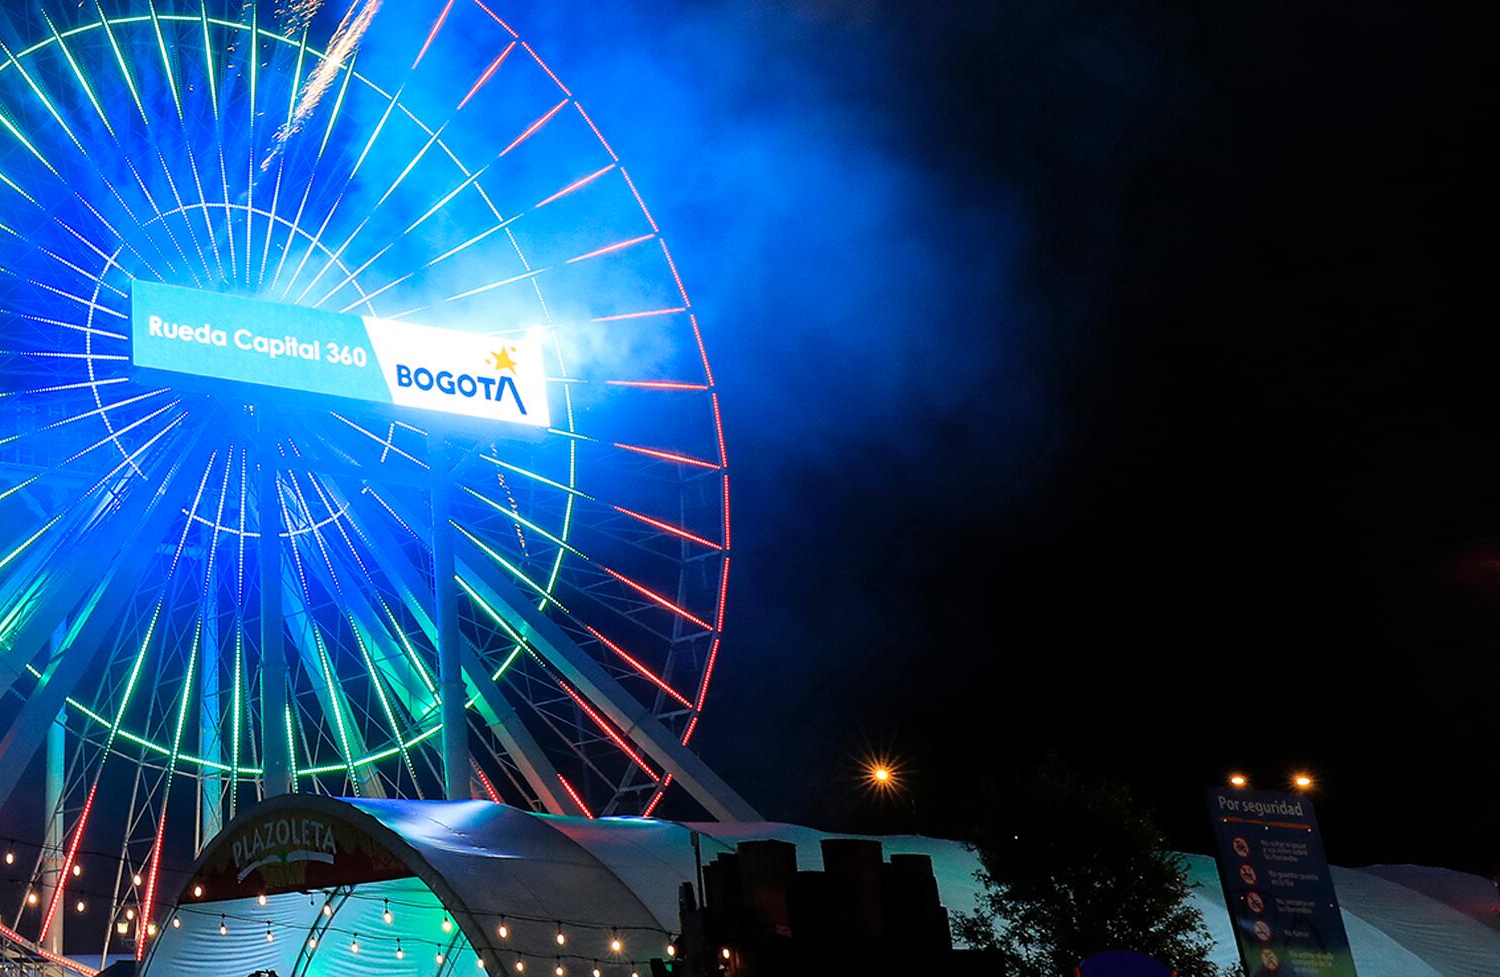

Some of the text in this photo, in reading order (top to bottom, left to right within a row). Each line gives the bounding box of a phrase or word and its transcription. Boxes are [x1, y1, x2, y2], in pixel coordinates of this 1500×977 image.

[148, 315, 368, 368] Rueda Capital 360
[1218, 795, 1304, 817] Por seguridad
[232, 818, 337, 867] PLAZOLETA
